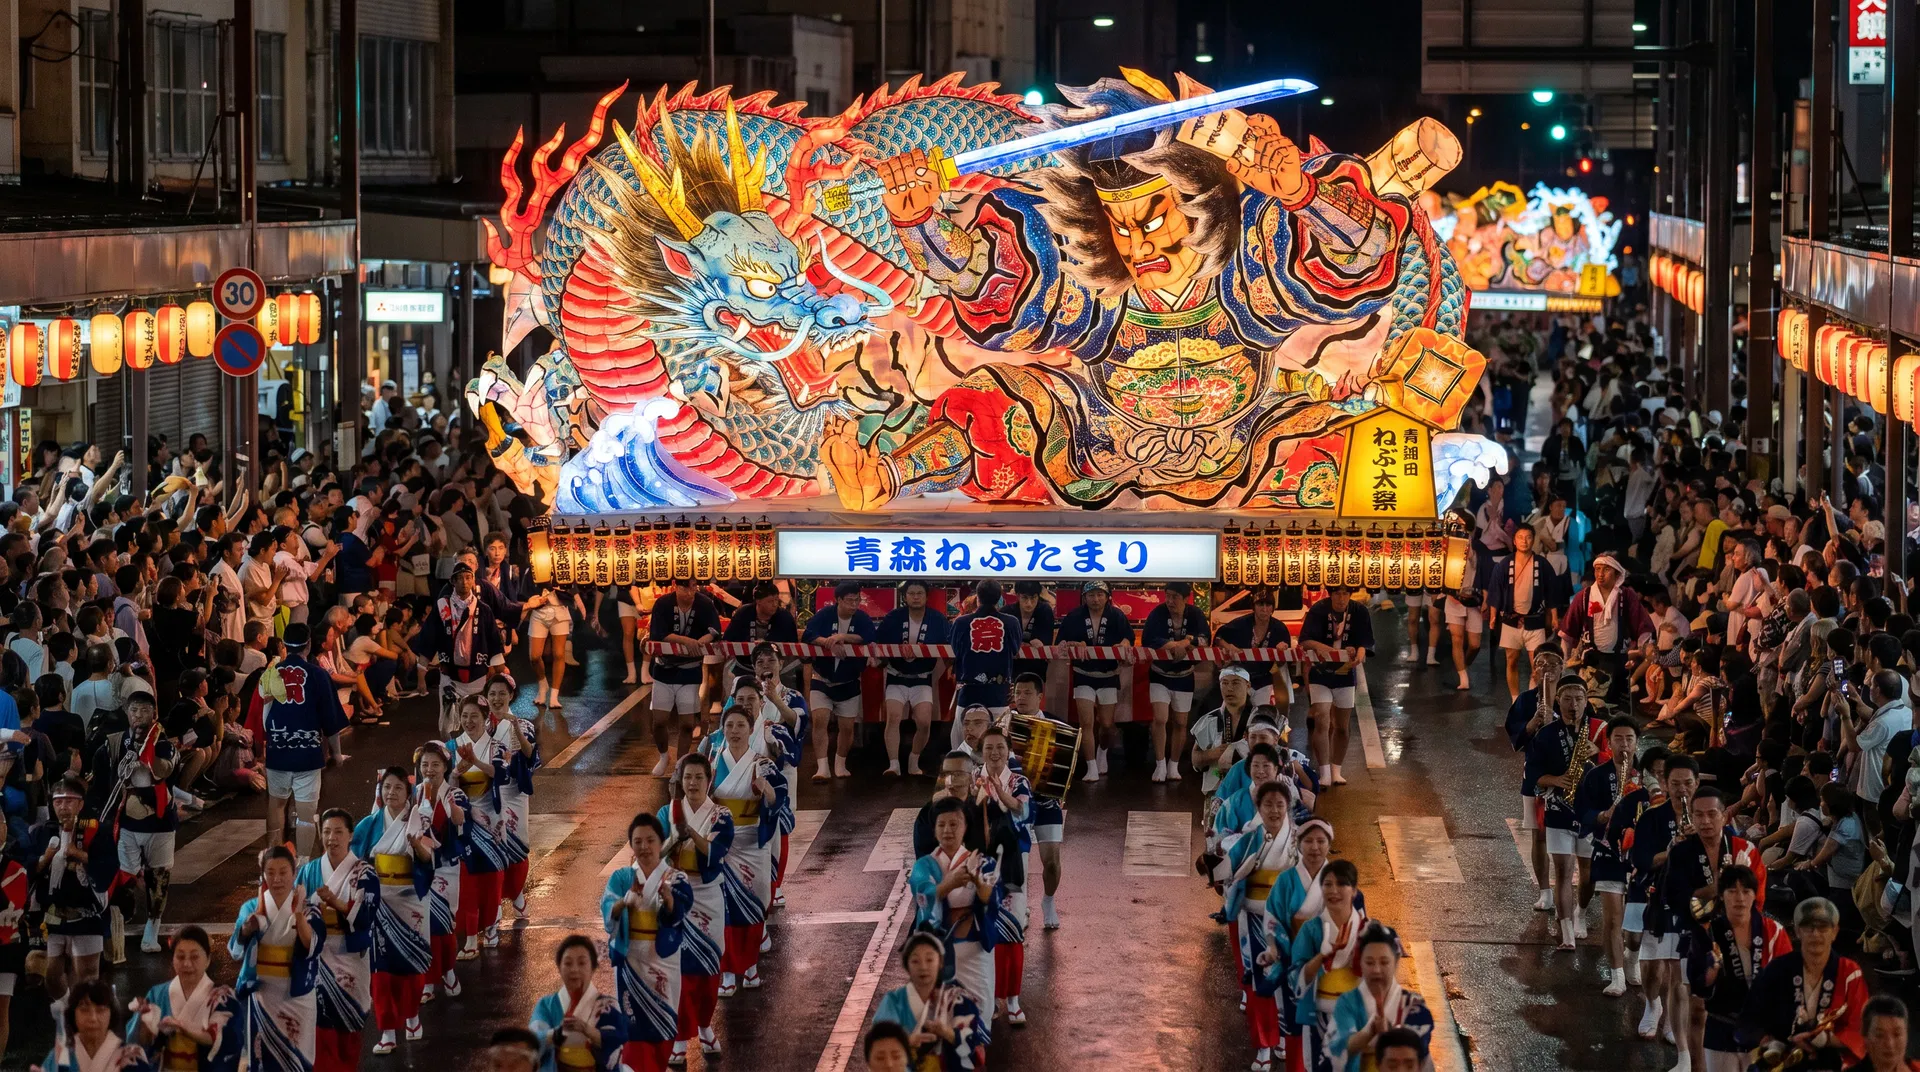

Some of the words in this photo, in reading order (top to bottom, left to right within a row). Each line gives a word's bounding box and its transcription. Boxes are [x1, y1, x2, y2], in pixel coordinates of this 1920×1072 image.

[225, 281, 254, 306] 30
[845, 536, 1147, 573] 青森ねぶたまり
[971, 615, 1005, 653] 祭
